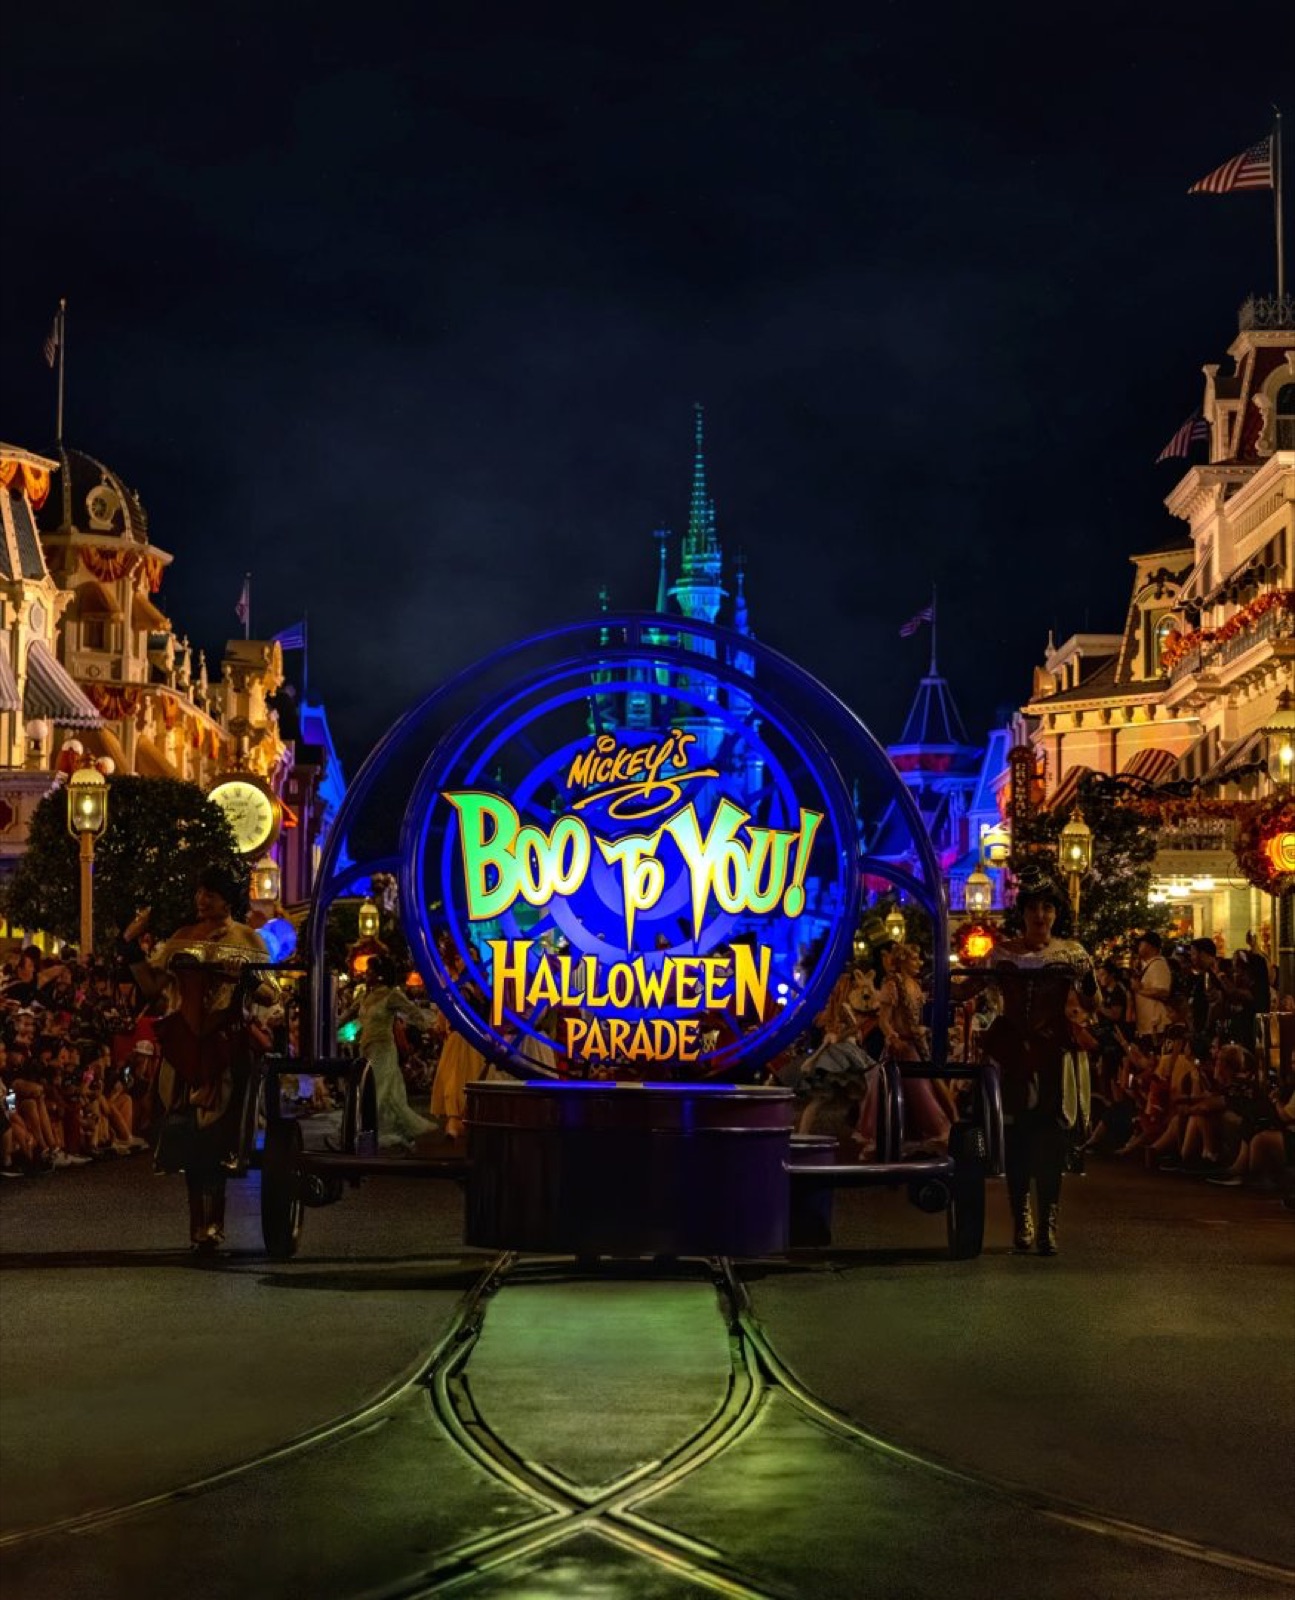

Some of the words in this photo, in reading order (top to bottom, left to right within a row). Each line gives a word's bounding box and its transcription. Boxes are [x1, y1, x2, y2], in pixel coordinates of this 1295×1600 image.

[567, 729, 705, 803] MICKEY'S
[442, 791, 591, 920] BOO
[662, 798, 824, 953] YOU!
[488, 940, 771, 1026] HALLOWEEN
[563, 1017, 701, 1061] PARADE
